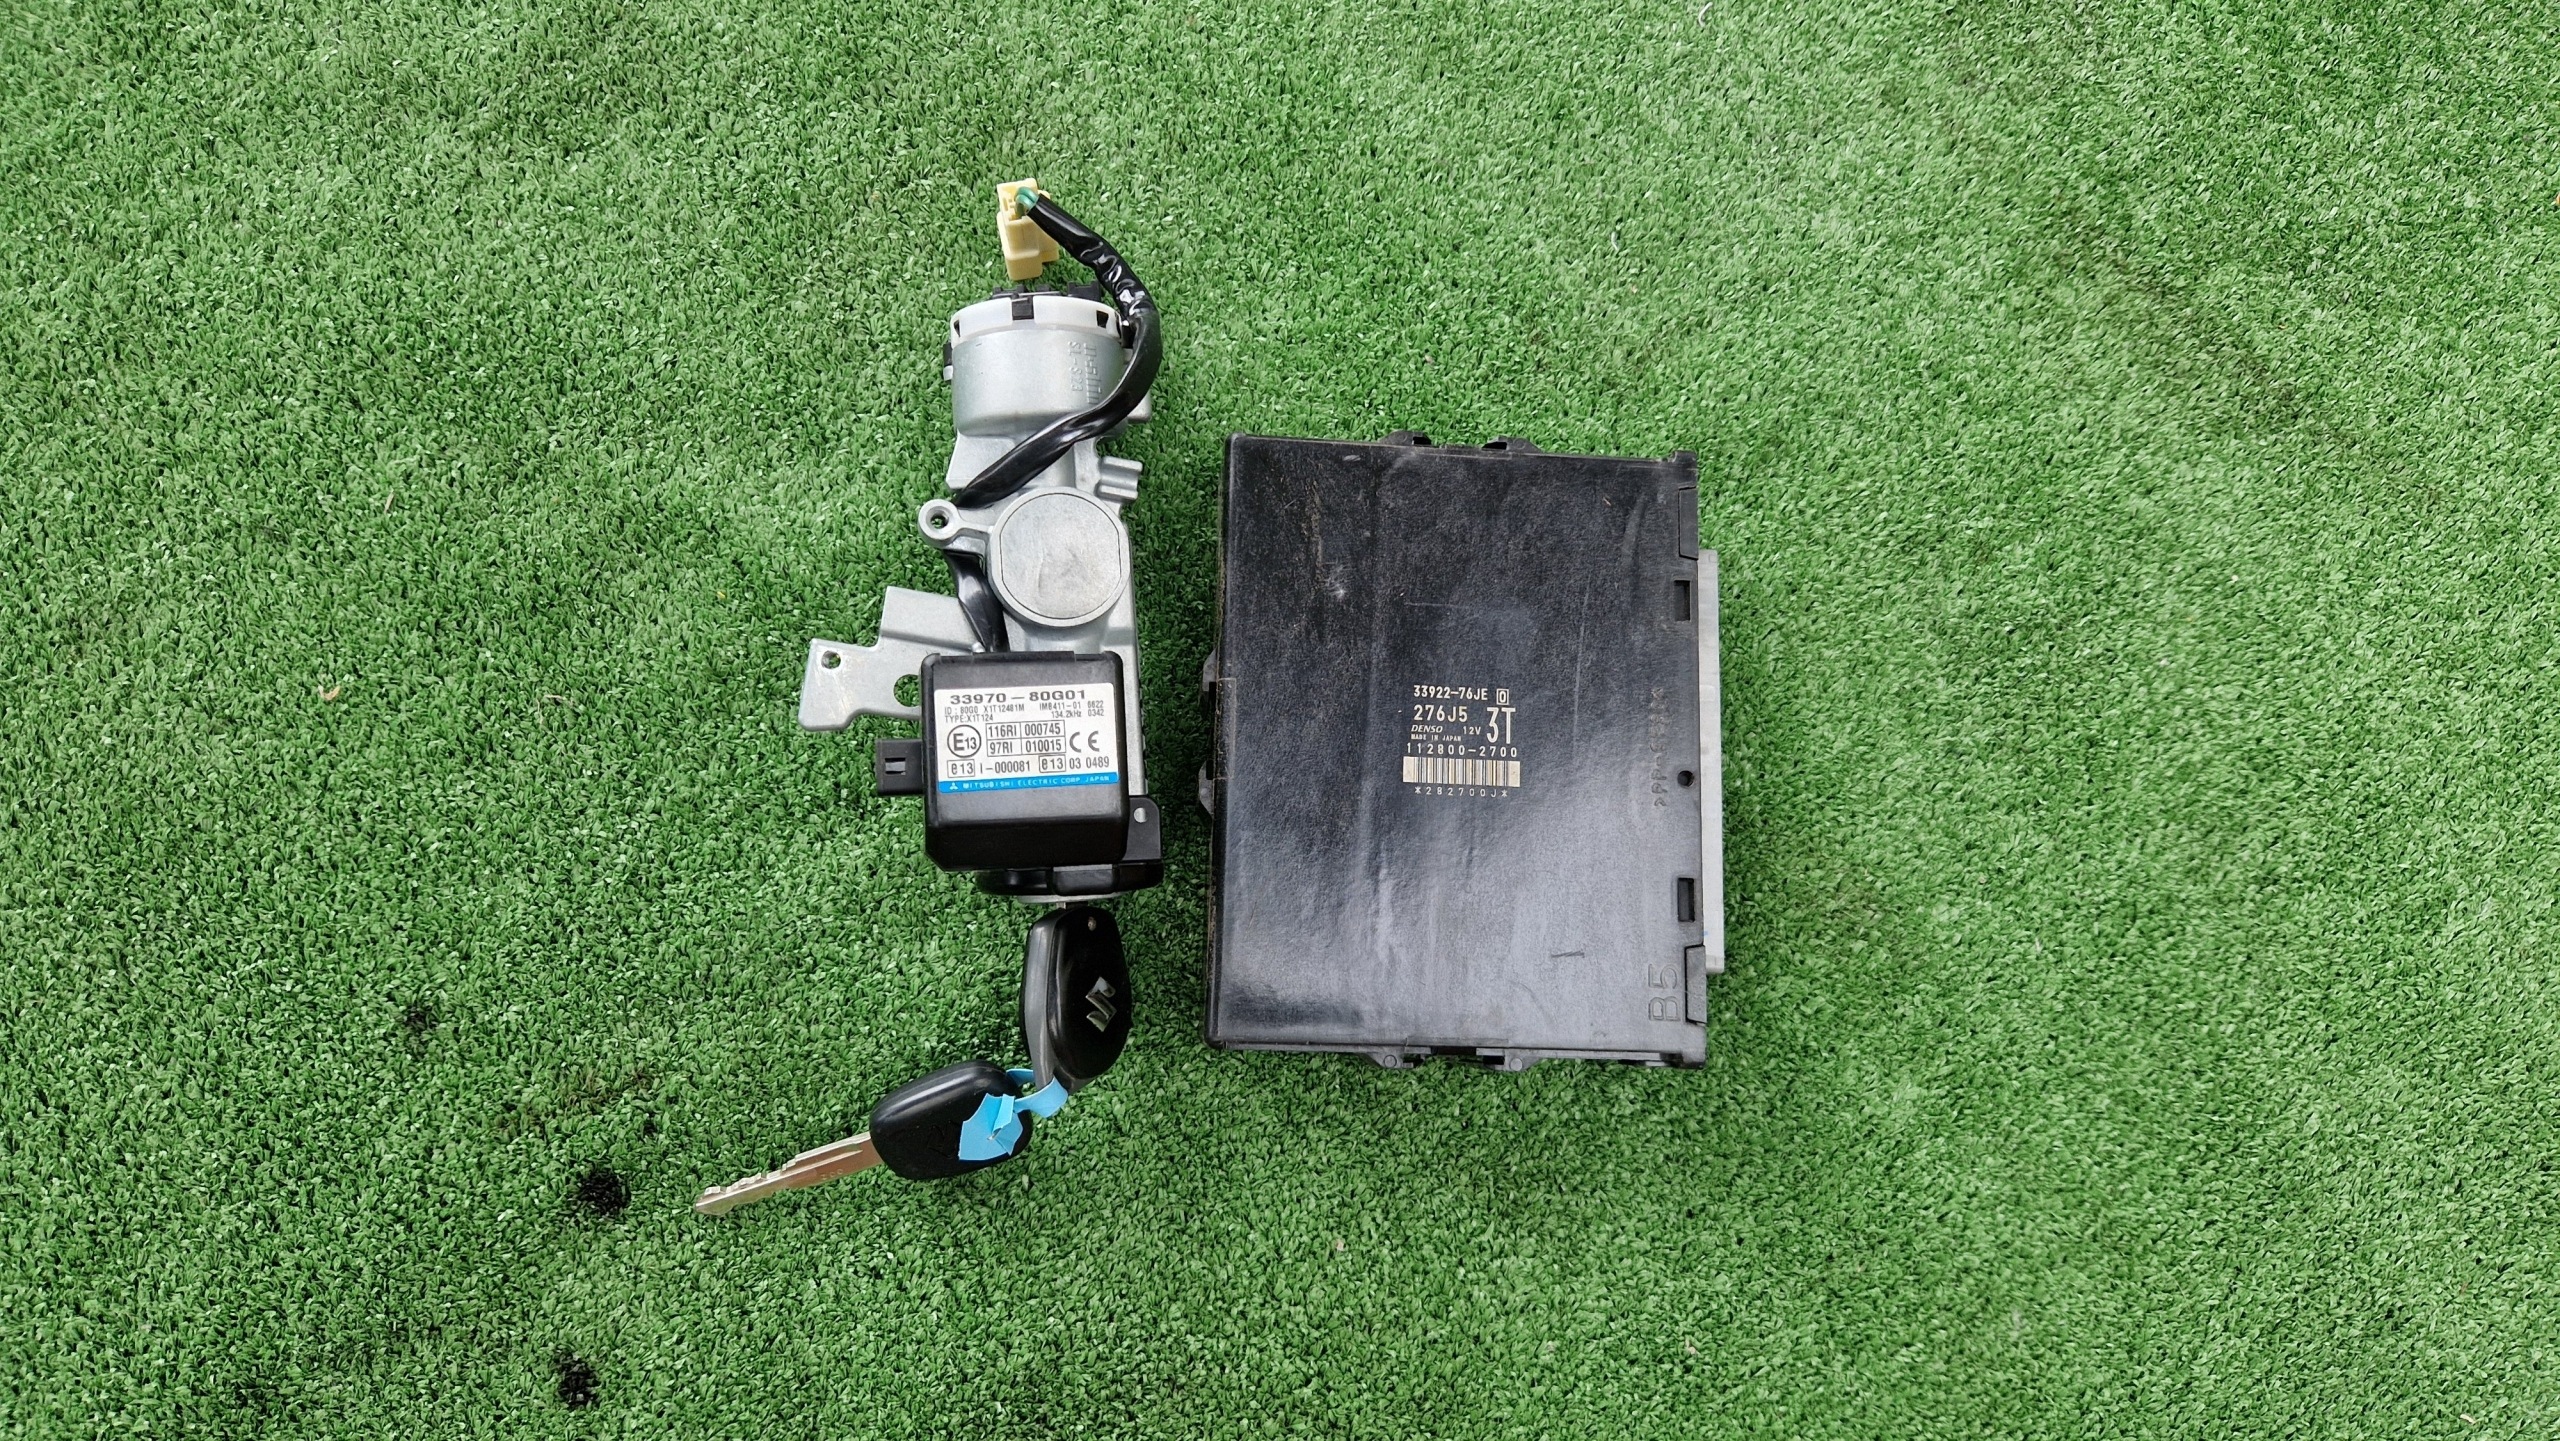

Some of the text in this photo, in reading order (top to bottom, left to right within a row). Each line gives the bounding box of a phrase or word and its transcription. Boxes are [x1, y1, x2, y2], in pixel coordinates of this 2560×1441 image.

[1413, 685, 1488, 701] 33922-76JE
[1087, 708, 1105, 717] 0342
[1024, 723, 1061, 736] 000745
[1411, 724, 1481, 735] DENSO 12V
[1413, 704, 1516, 745] 276J5 3T
[1025, 738, 1062, 752] 010015
[1407, 742, 1517, 758] 112800-2700
[962, 781, 1014, 789] MITSUBISHI
[1017, 778, 1058, 786] ELECTRIC
[1084, 775, 1110, 783] JAPAN
